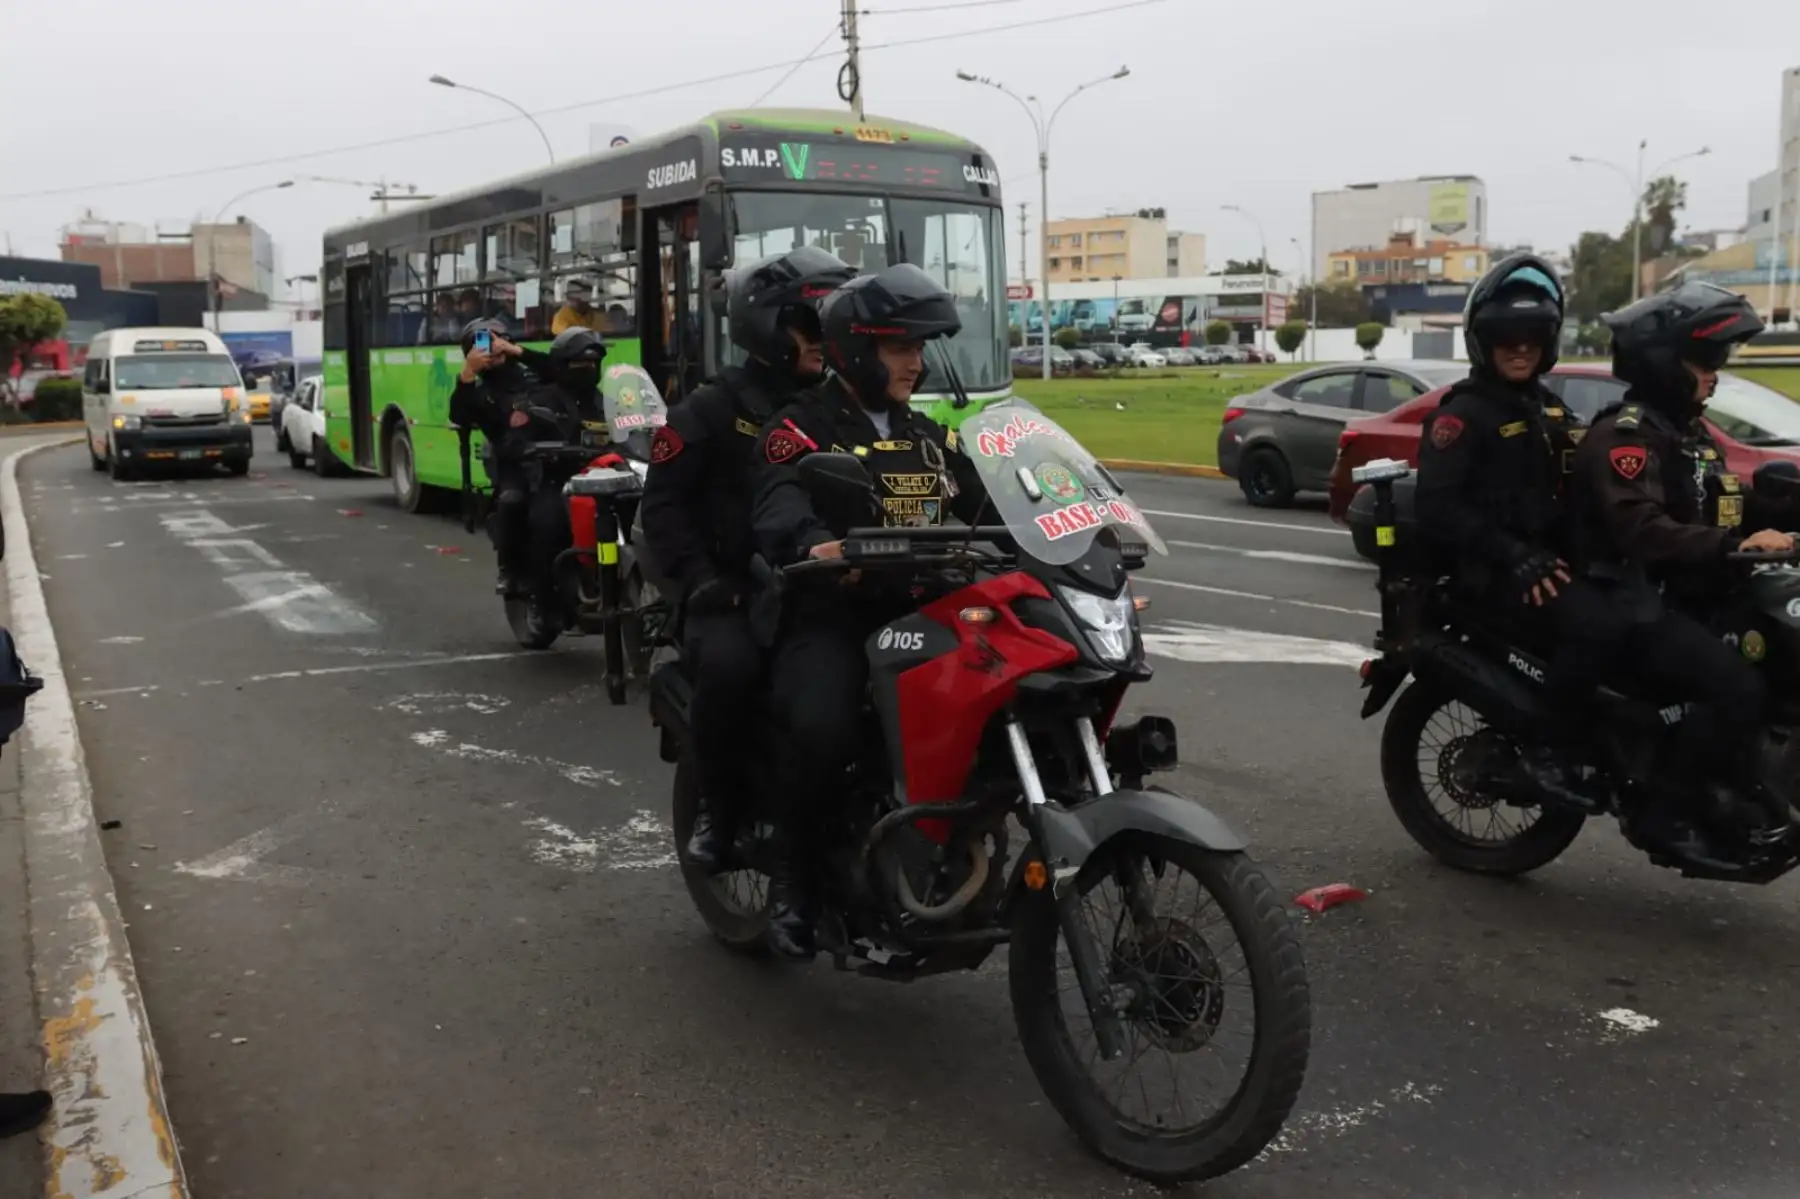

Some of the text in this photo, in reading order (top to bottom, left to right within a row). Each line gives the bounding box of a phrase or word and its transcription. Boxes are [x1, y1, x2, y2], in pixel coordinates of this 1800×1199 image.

[721, 148, 781, 168] S.M.P.
[646, 158, 697, 189] SUBIDA
[1035, 502, 1101, 541] BASE
[893, 631, 925, 650] 105
